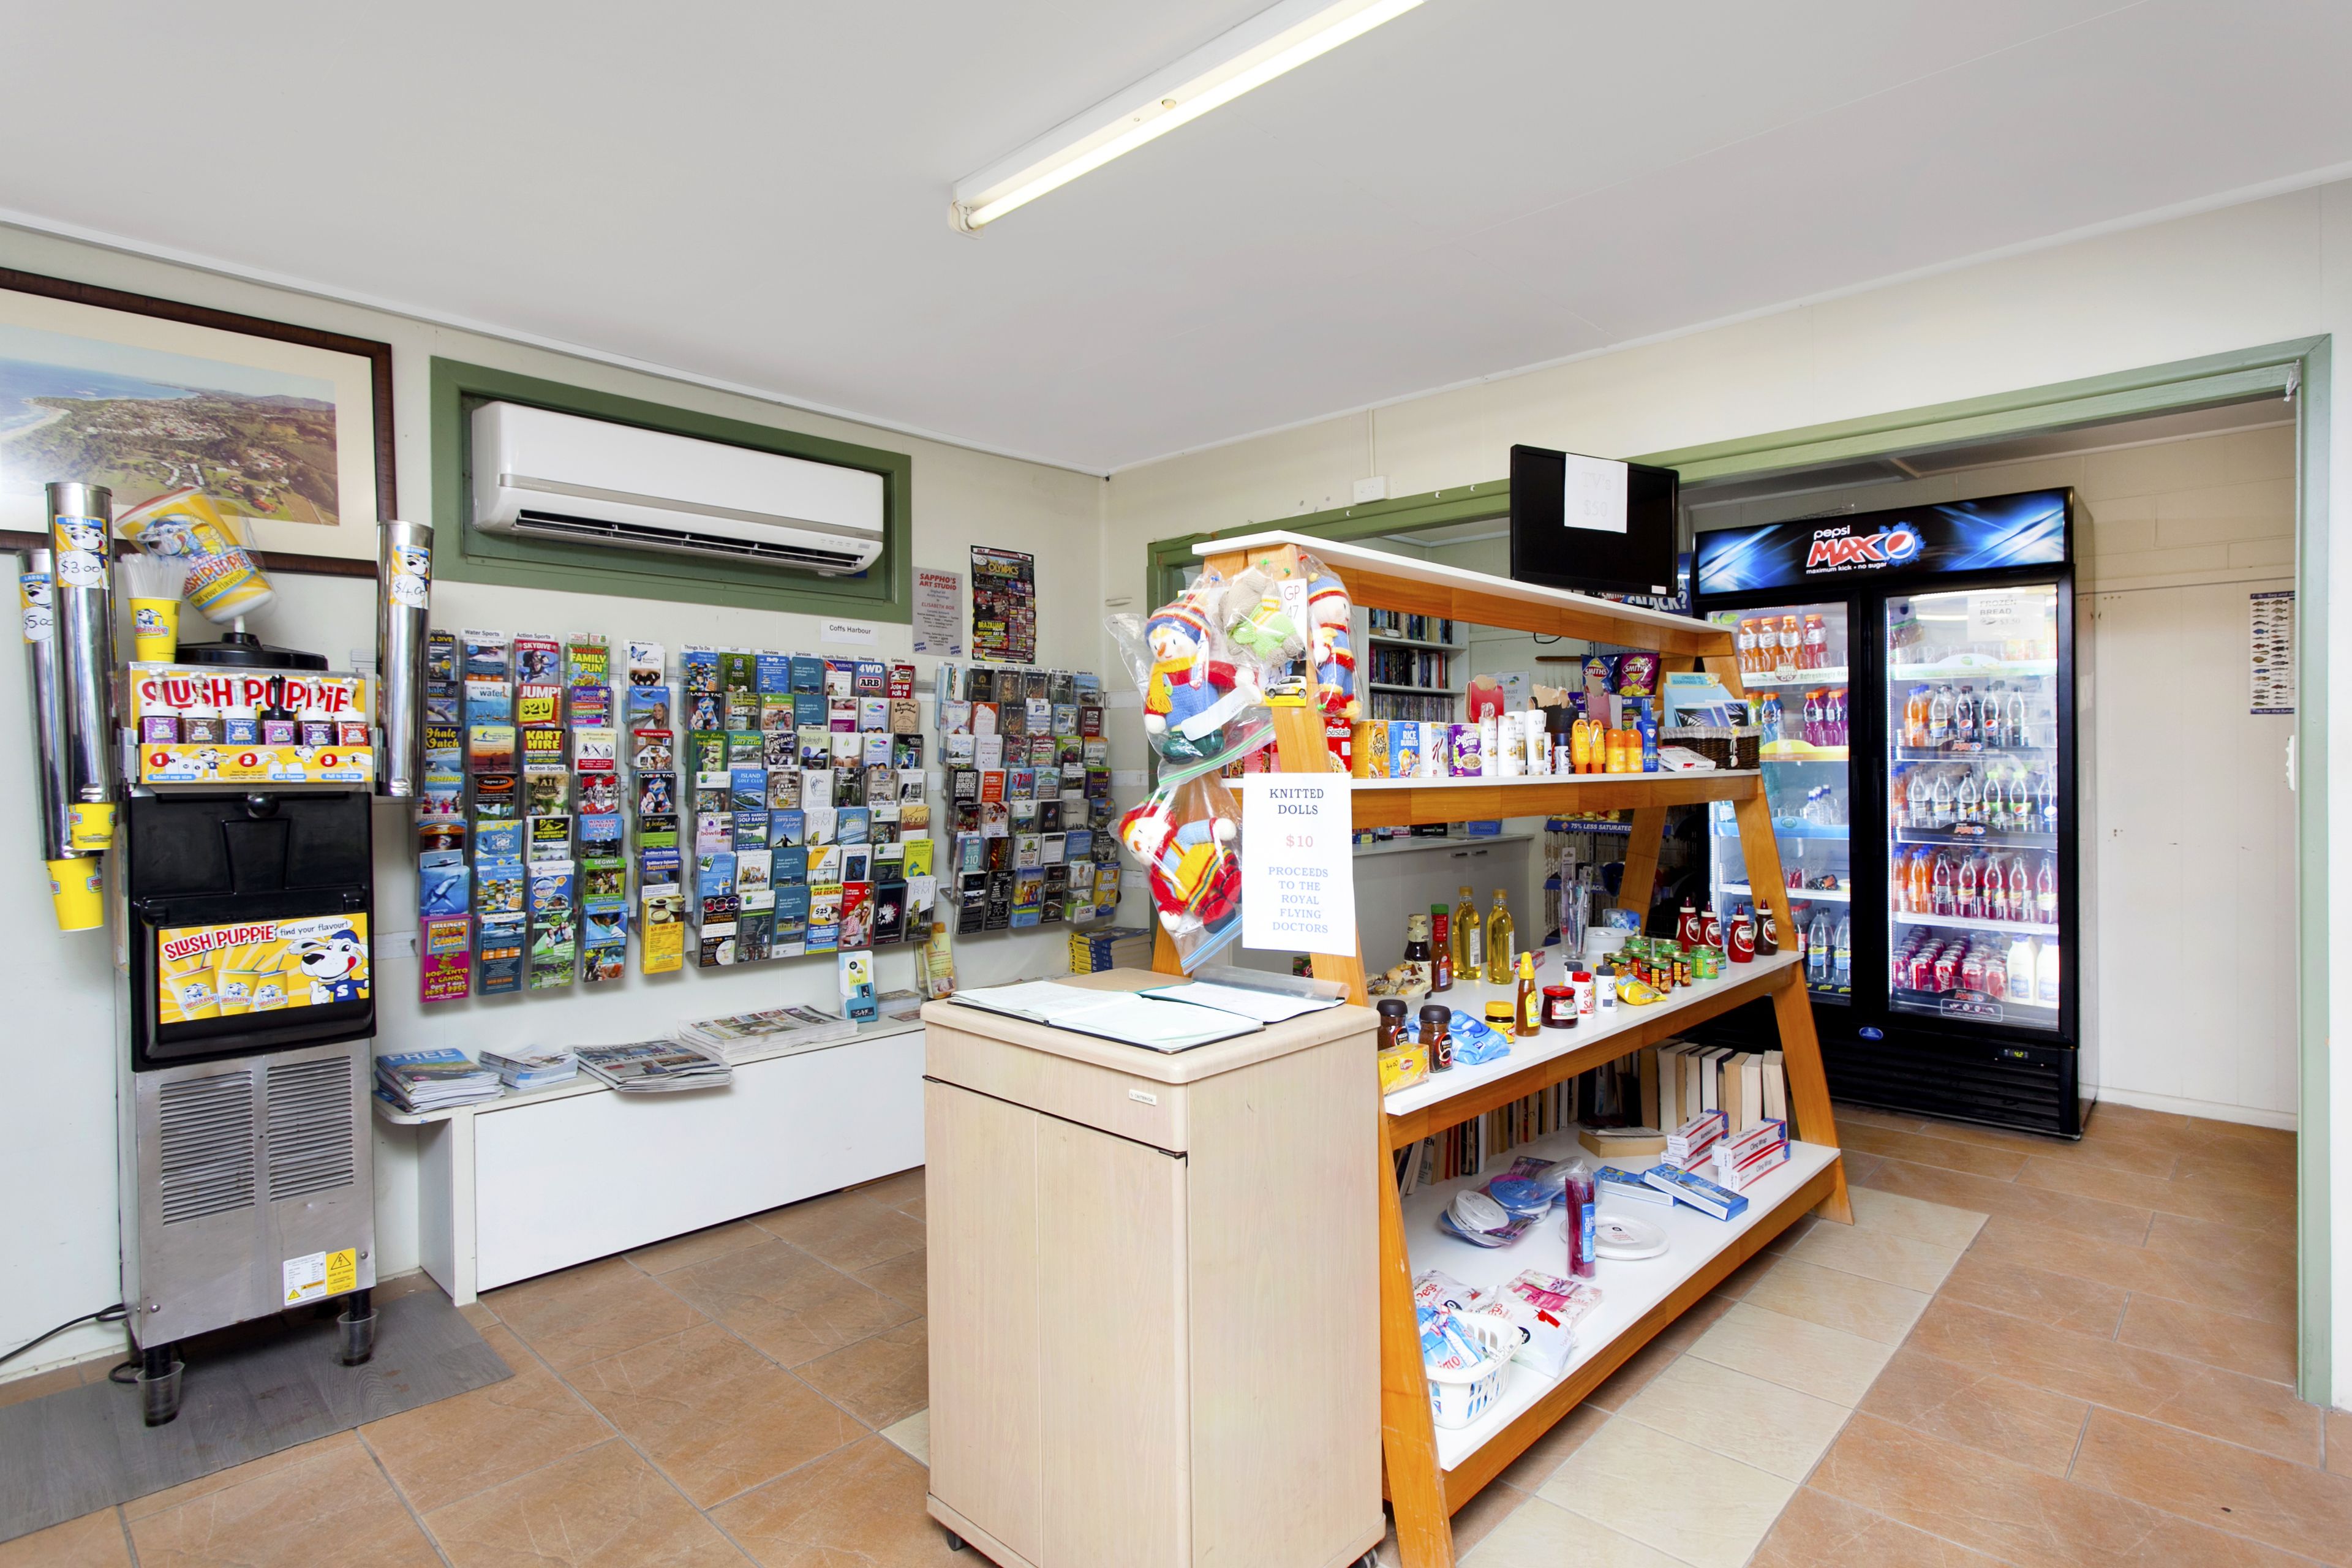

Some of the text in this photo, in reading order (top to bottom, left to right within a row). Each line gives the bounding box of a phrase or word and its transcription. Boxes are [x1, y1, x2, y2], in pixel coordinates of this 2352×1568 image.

[1581, 472, 1611, 490] TV's
[1585, 499, 1608, 517] $50
[1814, 525, 1850, 540] pepsi
[1806, 532, 1890, 568] MAX
[987, 563, 1019, 575] OLYMPICS
[1868, 562, 1887, 570] sugar
[919, 573, 957, 584] SAPPHO'S
[1284, 585, 1300, 602] GP
[921, 601, 945, 610] ELISABETH
[1980, 598, 2017, 607] FROZEN
[847, 626, 872, 635] Harbour
[522, 642, 551, 650] SKYDIVE
[571, 653, 606, 663] FAMILY
[581, 663, 603, 673] FUN
[859, 664, 883, 674] 4WD
[861, 679, 880, 687] ARB
[141, 678, 233, 709] SLUSH
[521, 685, 562, 699] JUMP!
[526, 730, 562, 741] KART
[1326, 726, 1351, 737] Sustain
[1403, 731, 1417, 740] RICE
[1373, 733, 1385, 746] Just
[1455, 731, 1480, 746] Sultana
[1462, 738, 1478, 749] Bran
[527, 740, 560, 750] HIRE
[1373, 743, 1387, 758] Right
[156, 755, 162, 764] 1
[243, 755, 252, 764] 2
[324, 755, 333, 765] 3
[1269, 788, 1324, 799] KNITTED
[1278, 804, 1319, 815] DOLLS
[1286, 834, 1313, 848] $10
[965, 854, 979, 865] $10
[1268, 866, 1329, 878] PROCEEDS
[1278, 880, 1321, 891] TO THE
[1281, 894, 1319, 905] ROYAL
[1280, 908, 1322, 919] FLYING
[280, 920, 349, 937] find your flavour!
[1272, 921, 1329, 933] DOCTORS
[164, 930, 214, 960] SLUSH
[387, 1049, 457, 1061] FREE
[1749, 1137, 1768, 1150] Cling Wrap
[1755, 1158, 1773, 1172] Cling Wrap
